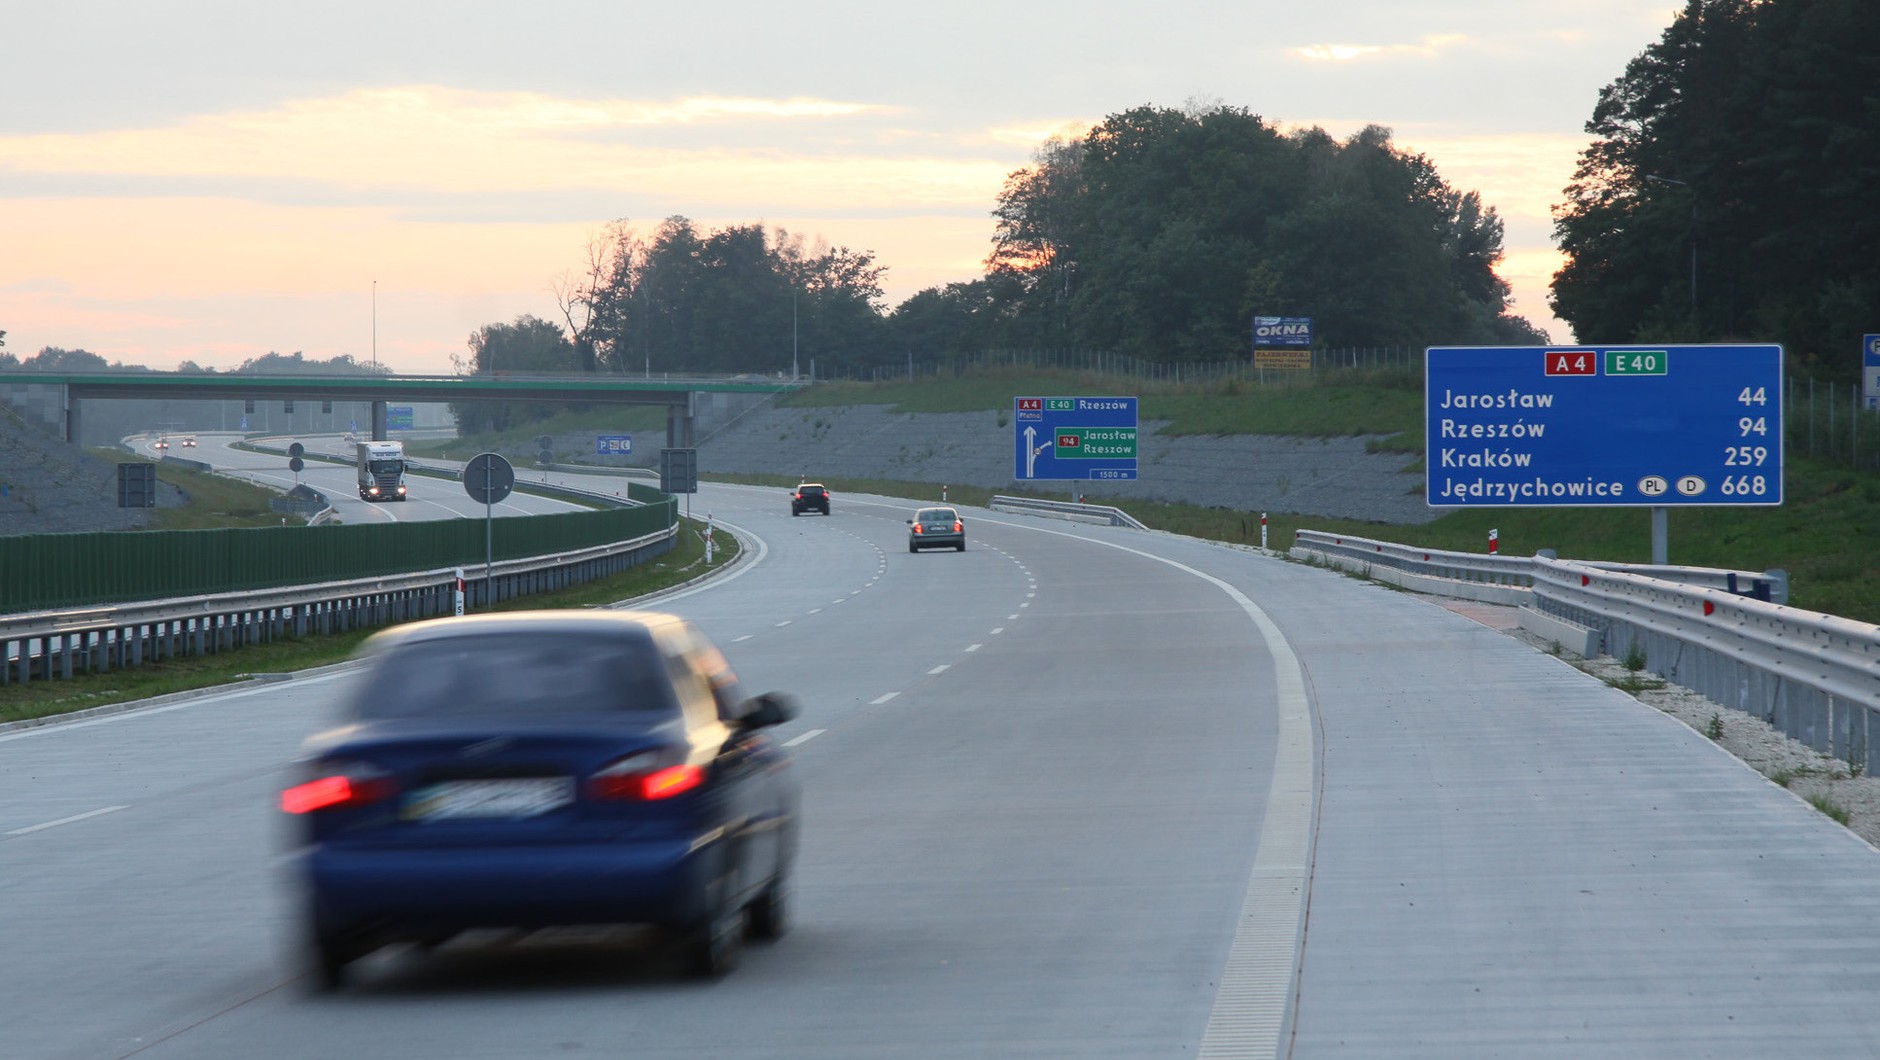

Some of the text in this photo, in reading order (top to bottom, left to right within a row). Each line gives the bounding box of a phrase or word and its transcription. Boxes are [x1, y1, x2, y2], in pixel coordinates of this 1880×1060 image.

[1256, 325, 1308, 336] OKNA
[1556, 355, 1586, 372] A 4
[1616, 355, 1656, 372] E 40
[1441, 386, 1767, 409] Jarosław 44
[1080, 400, 1128, 410] Rzeszów
[1441, 416, 1767, 439] Rzeszów 94
[1062, 438, 1074, 446] 94
[1083, 430, 1136, 440] Jarosław
[1084, 444, 1132, 454] Rzeszów
[1441, 446, 1768, 468] Kraków 259
[1440, 475, 1767, 502] Jędrzychowice PL D 668
[457, 606, 462, 614] 5
